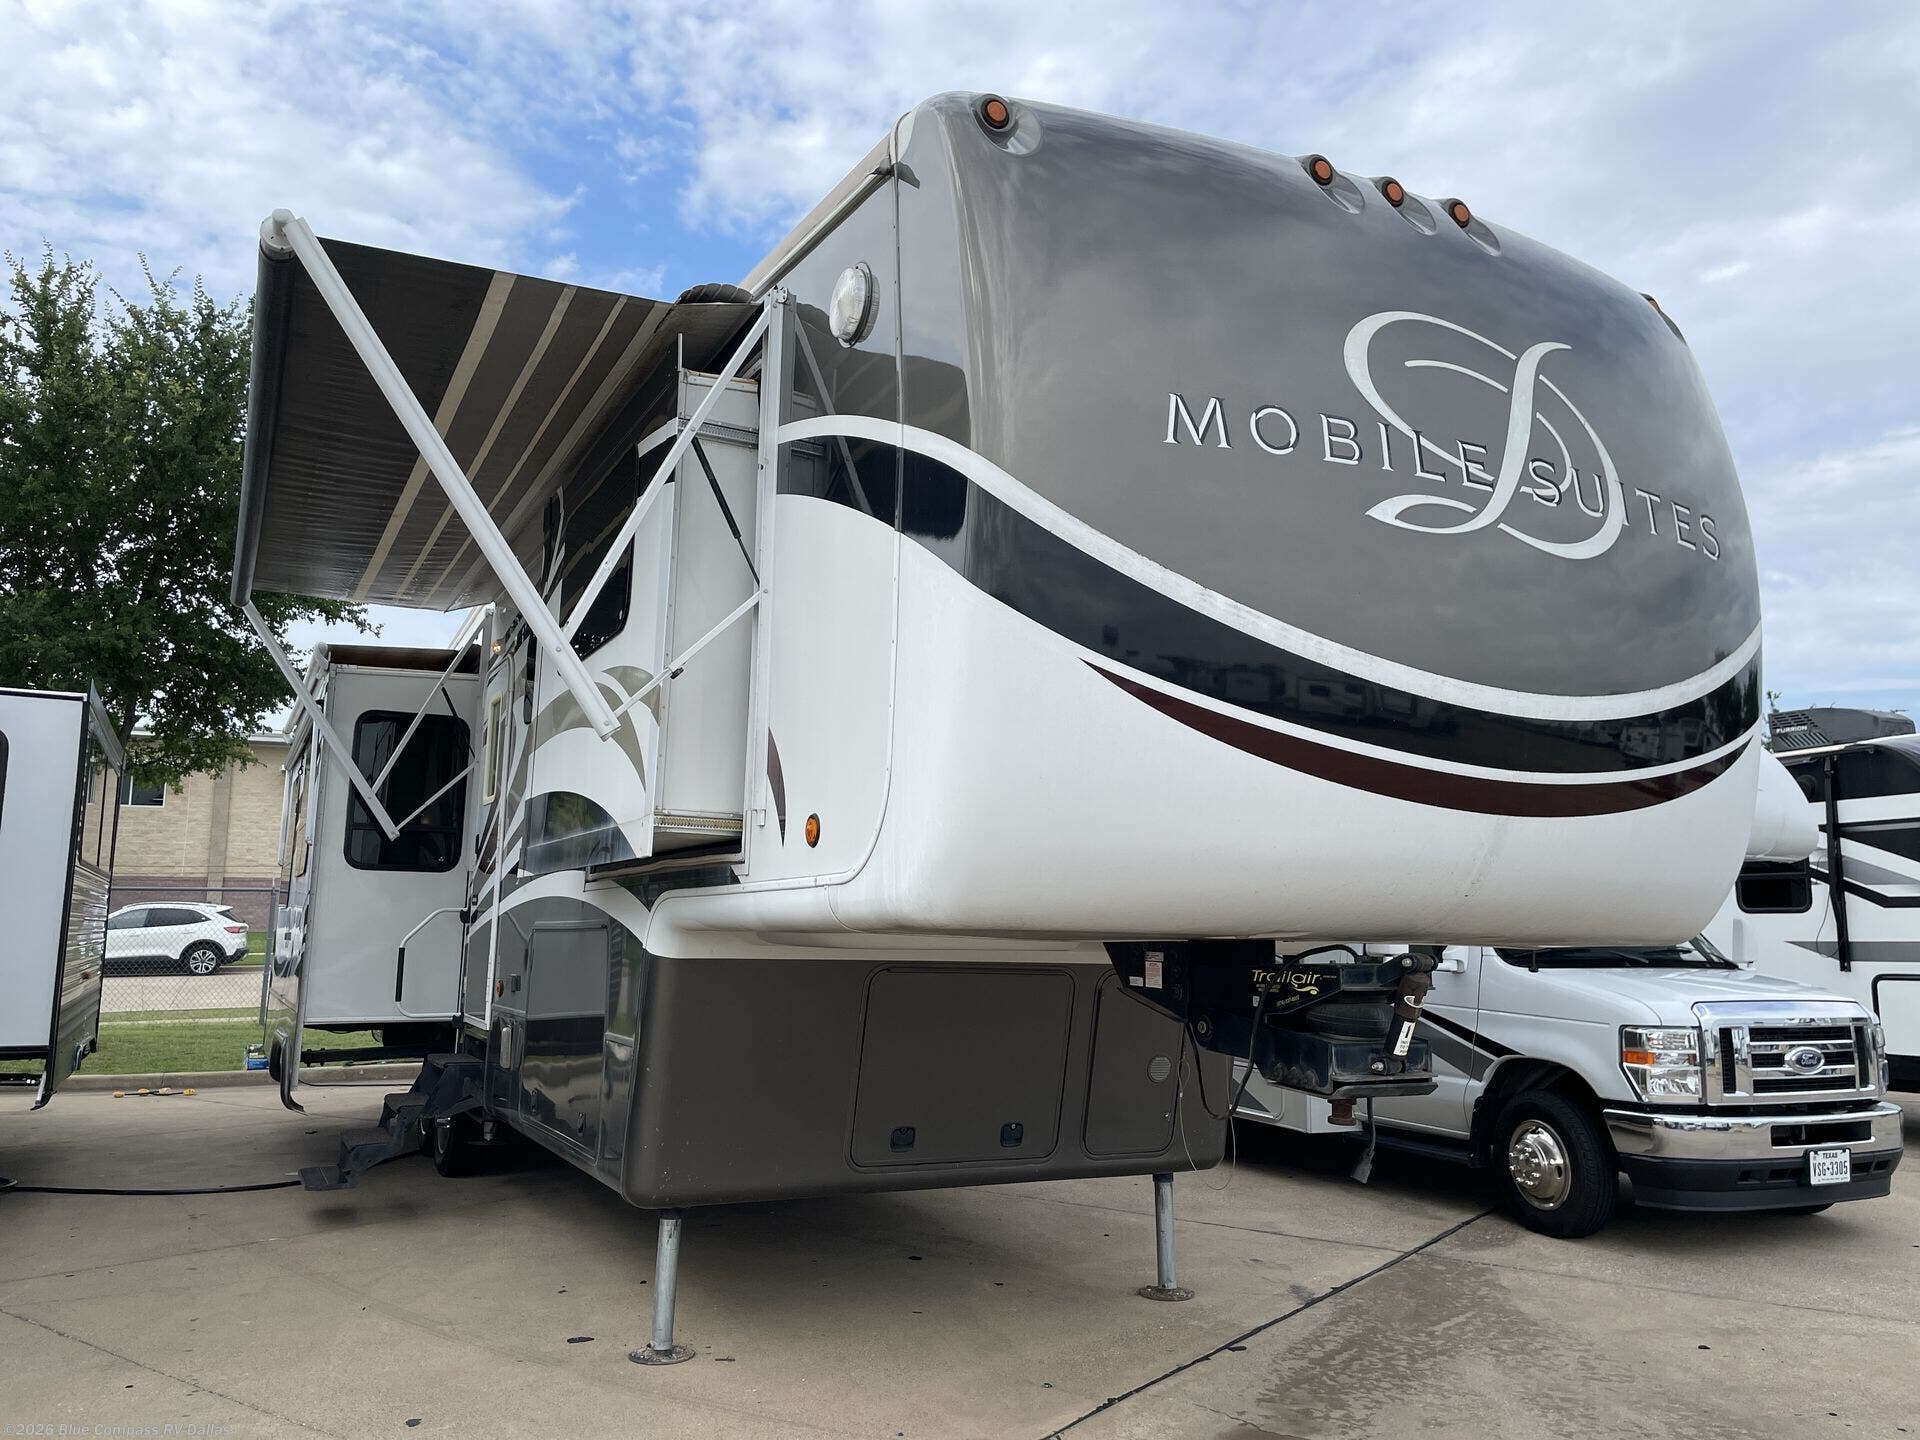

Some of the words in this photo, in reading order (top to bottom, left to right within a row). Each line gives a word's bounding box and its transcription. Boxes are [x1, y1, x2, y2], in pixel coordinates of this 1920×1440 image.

[1163, 392, 1495, 491] MOBILE
[1526, 457, 1722, 561] SUITES
[1776, 726, 1808, 734] FURRION
[1801, 1053, 1818, 1065] Ford
